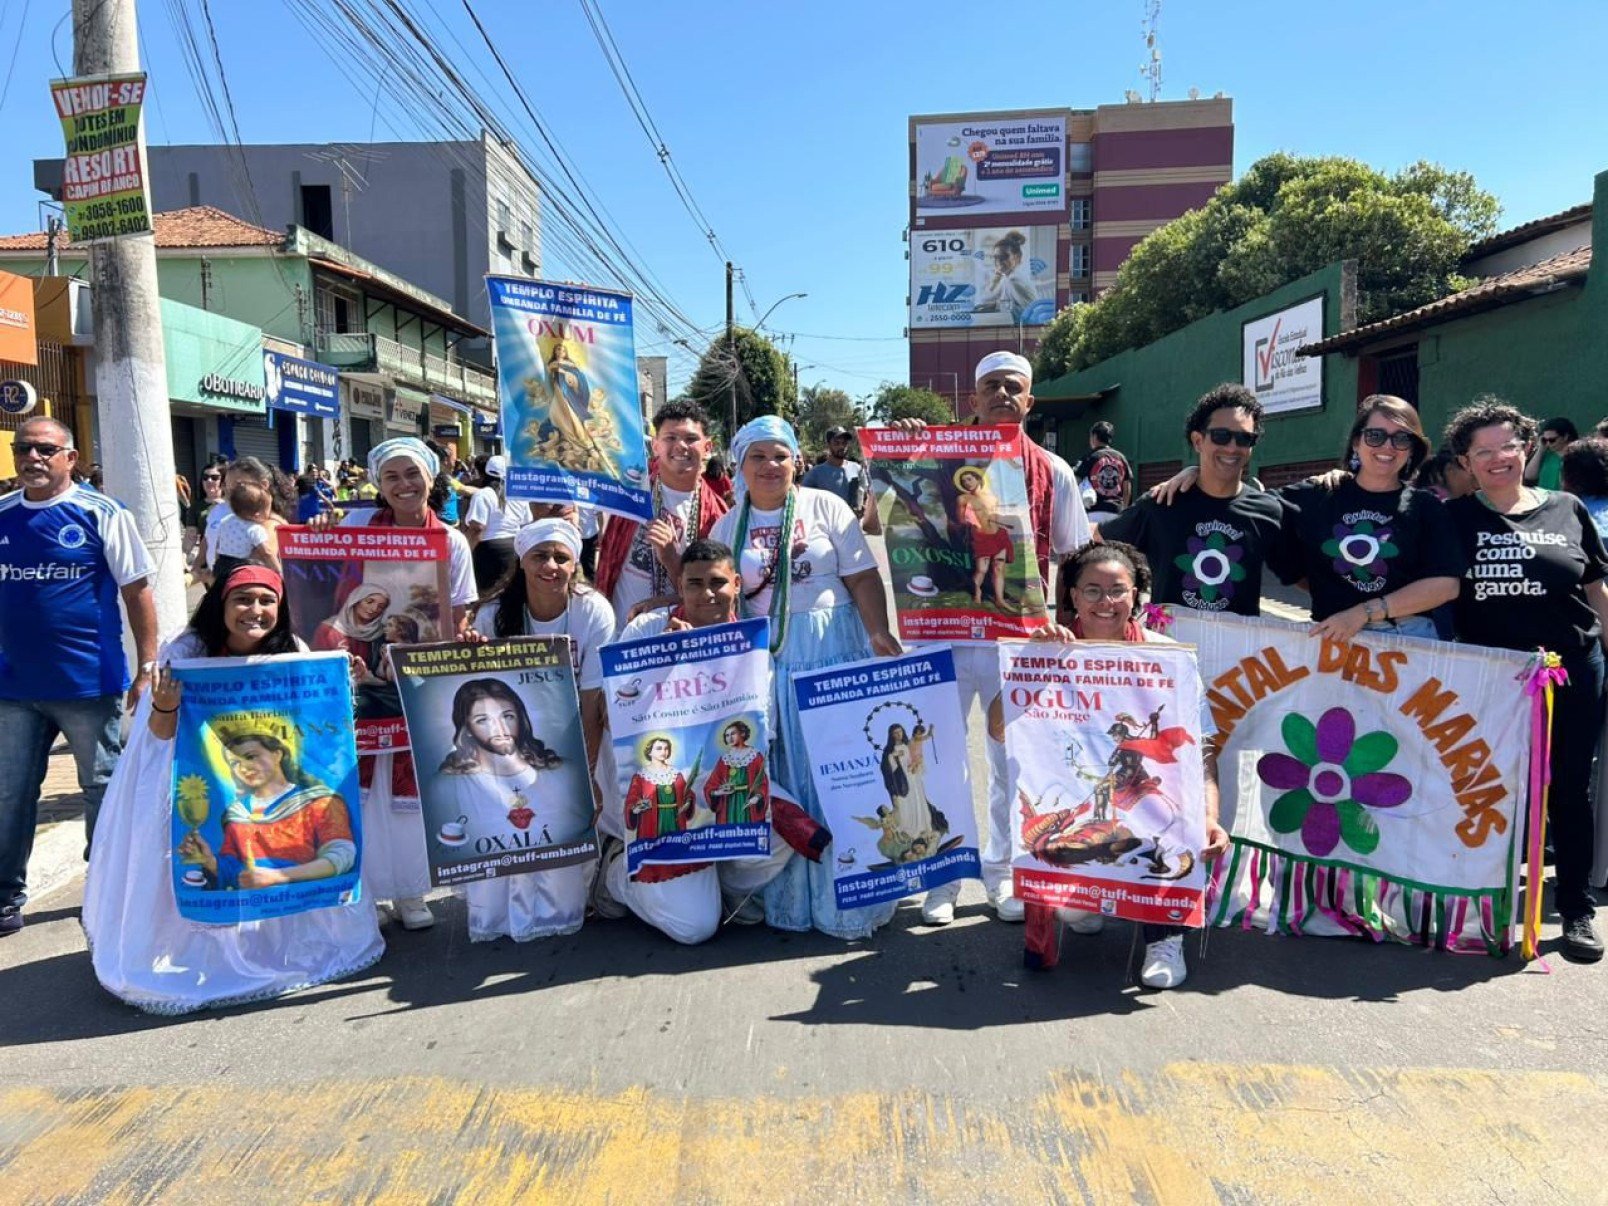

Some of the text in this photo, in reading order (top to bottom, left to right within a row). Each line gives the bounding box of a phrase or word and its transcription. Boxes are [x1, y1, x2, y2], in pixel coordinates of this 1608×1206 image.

[109, 108, 126, 126] EM
[962, 124, 1060, 139] Chegou quem faltava
[995, 138, 1007, 146] na
[1009, 136, 1025, 145] sua
[65, 145, 138, 183] RESORT
[87, 197, 144, 217] 3058-1600
[923, 239, 965, 253] 610
[504, 283, 619, 310] TEMPLO ESPÍRITA
[500, 296, 548, 311] UMBANDA
[597, 311, 611, 321] DE
[528, 318, 595, 344] OXUM
[935, 428, 1002, 442] ESPÍRITA
[870, 443, 926, 454] UMBANDA
[929, 442, 978, 454] FAMÍLIA
[980, 444, 996, 454] DE
[291, 531, 427, 547] TEMPLO ESPÍRITA
[1476, 528, 1569, 549] Pesquise
[285, 546, 348, 557] UMBANDA
[350, 546, 401, 559] FAMÍLIA
[404, 549, 420, 558] DE
[1475, 546, 1537, 561] como
[10, 562, 88, 581] betfair
[1474, 563, 1524, 579] uma
[1474, 578, 1548, 601] garota.
[407, 641, 548, 664] TEMPLO ESPÍRITA
[621, 630, 745, 660] TEMPLO ESPÍRITA
[402, 653, 560, 677] UMBANDA FAMÍLIA DE FÉ
[614, 656, 672, 672] UMBANDA
[675, 646, 721, 665] FAMÍLIA
[723, 643, 738, 655] DE
[1010, 656, 1163, 676] TEMPLO ESPÍRITA
[518, 671, 565, 686] JESUS
[655, 671, 728, 702] ERÊS
[814, 660, 933, 693] TEMPLO ESPÍRITA
[1003, 671, 1071, 685] UMBANDA
[1075, 673, 1132, 688] FAMÍLIA
[1137, 677, 1154, 688] DE
[809, 687, 864, 706] UMBANDA
[867, 678, 910, 696] FAMÍLIA
[913, 676, 927, 688] DE
[1010, 687, 1103, 712] OGUM
[1024, 709, 1091, 725] São Jorge
[1317, 638, 1408, 694] DAS
[1399, 676, 1508, 849] MARIAS
[475, 823, 553, 855] OXALÁ
[437, 842, 596, 878] instagram@tuff-umbanda
[837, 850, 976, 894] instagram@tuff-umbanda
[1020, 875, 1197, 910] instagram@tuff-umbanda
